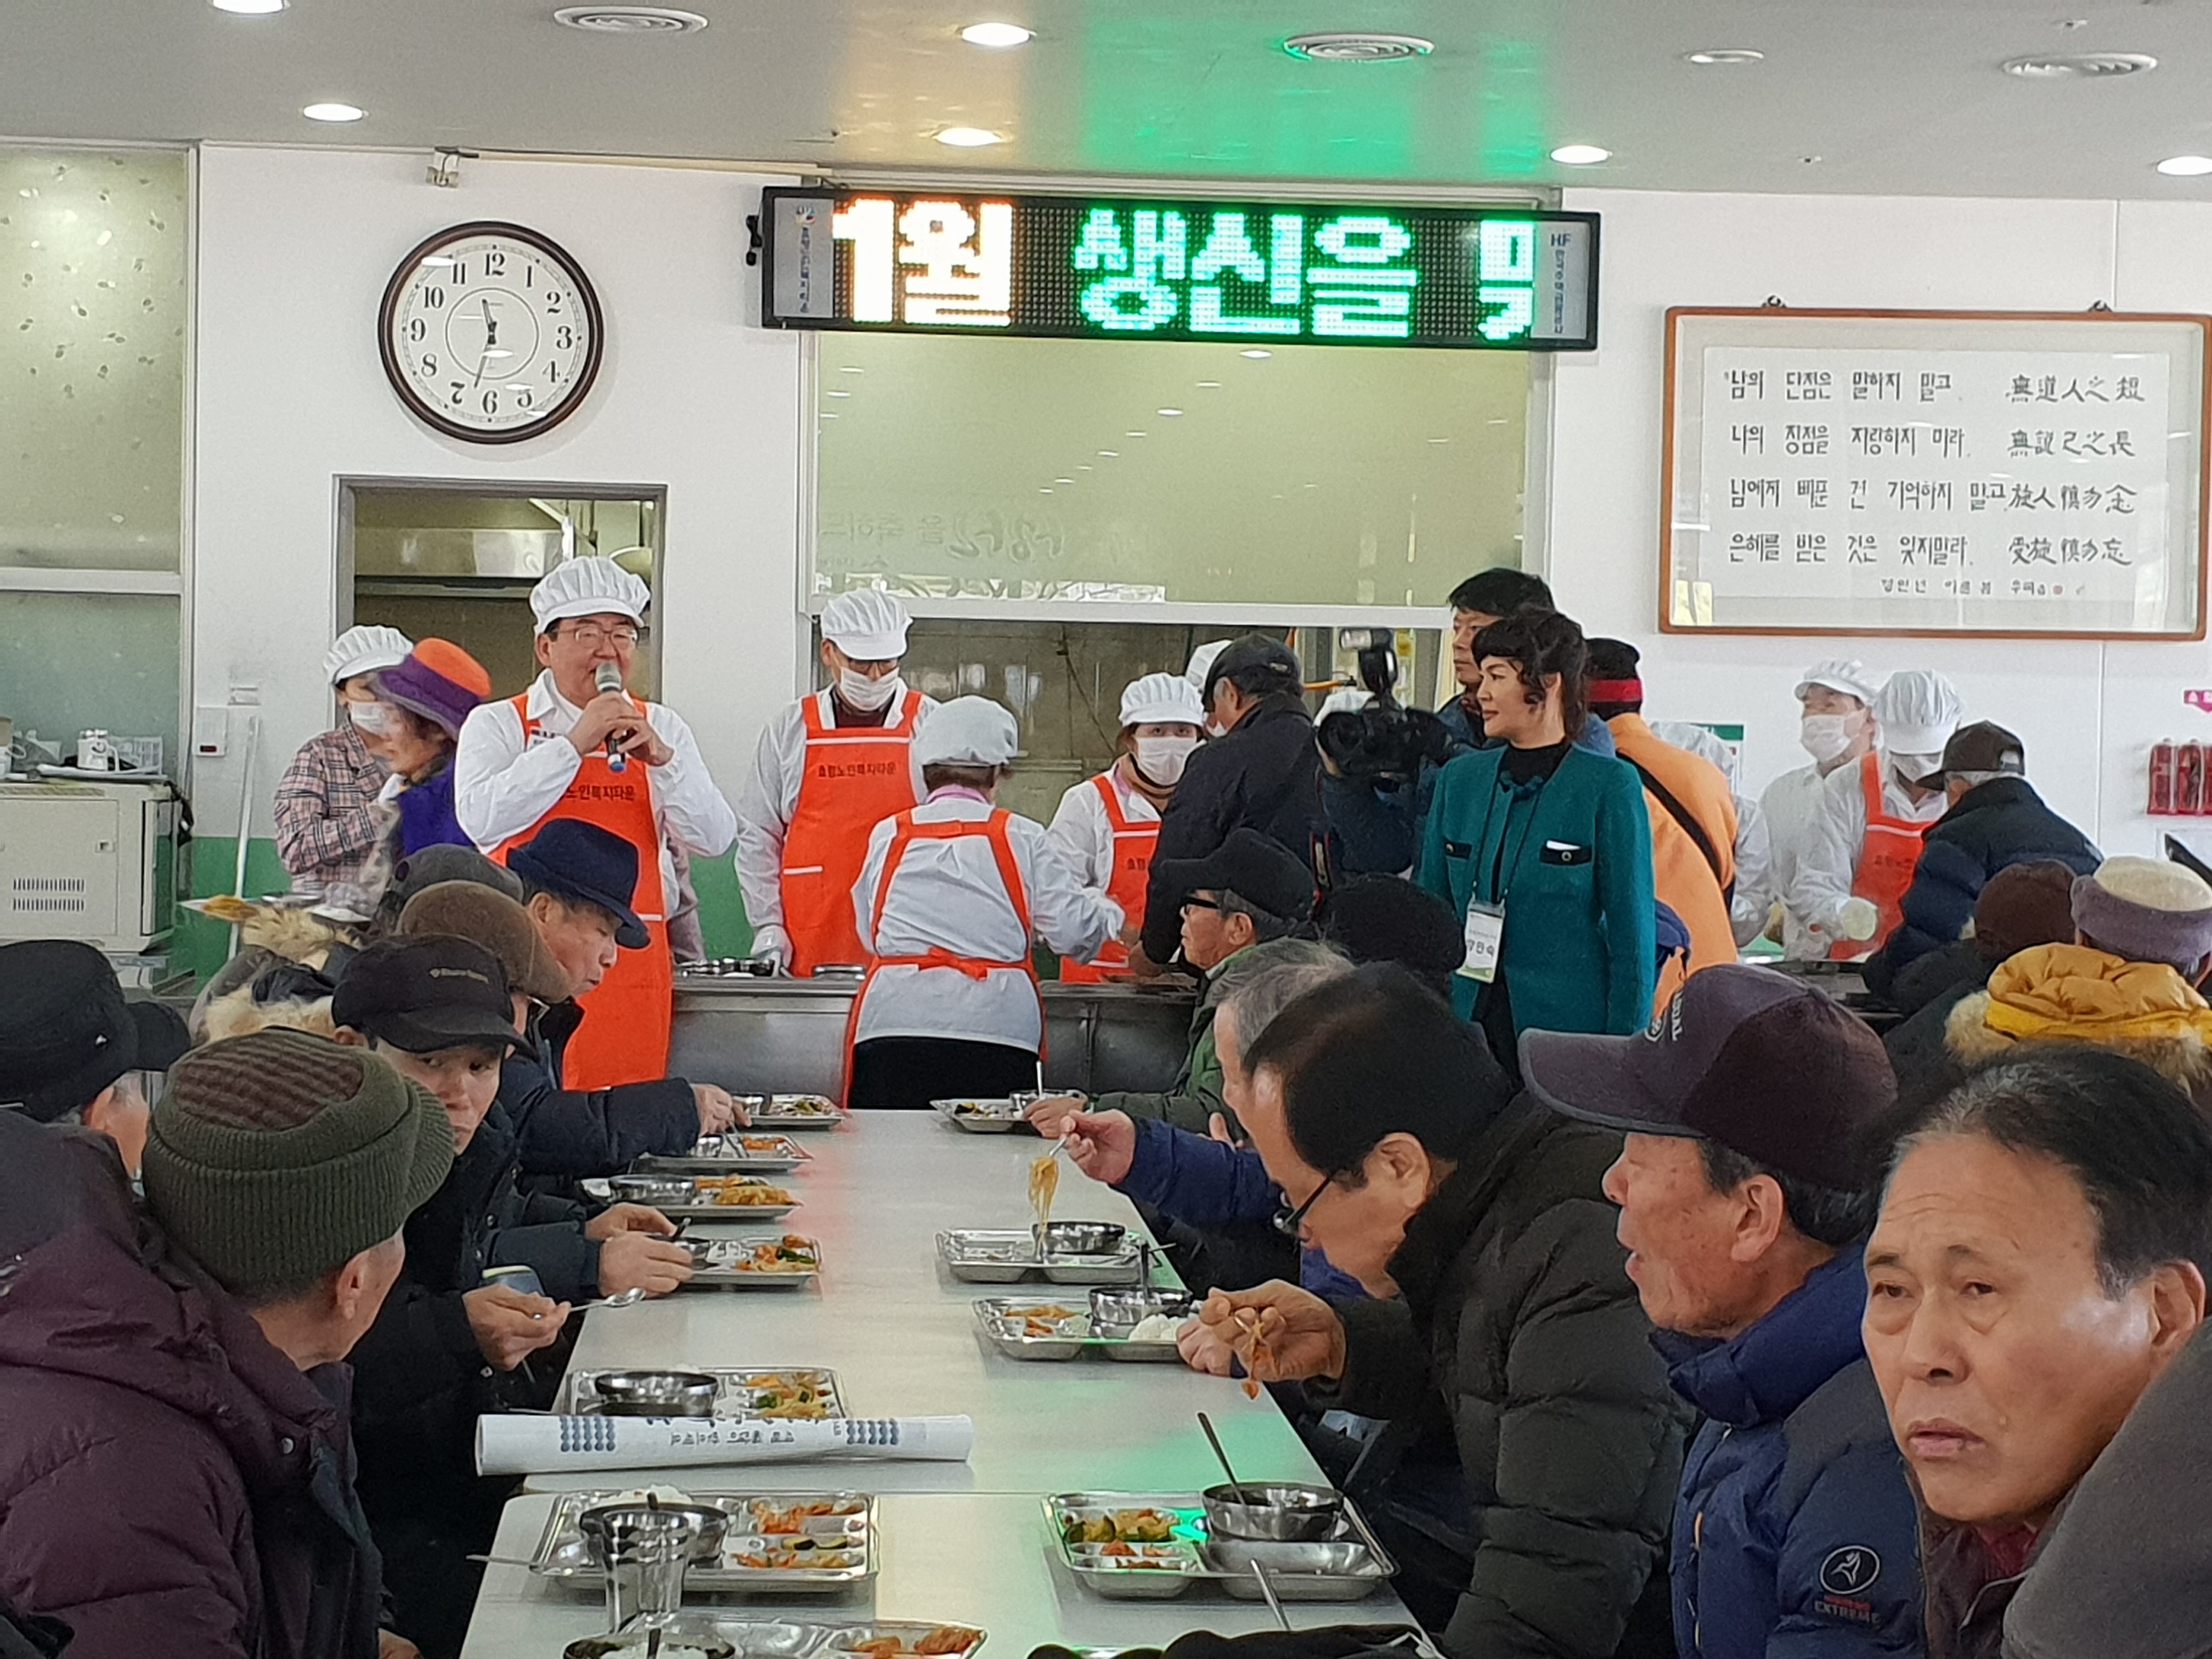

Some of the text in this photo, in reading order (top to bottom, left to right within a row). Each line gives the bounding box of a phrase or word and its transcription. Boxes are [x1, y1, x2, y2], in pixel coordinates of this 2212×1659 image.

[452, 262, 466, 285] 11
[484, 253, 505, 276] 12
[526, 265, 532, 288] 1
[832, 198, 1013, 326] 1월
[1073, 208, 1416, 337] 생신을
[424, 286, 444, 309] 10
[546, 291, 561, 314] 2
[410, 318, 426, 342] 9
[556, 325, 573, 350] 3
[421, 353, 437, 377] 8
[542, 360, 560, 383] 4
[450, 381, 465, 404] 7
[517, 387, 533, 408] 5
[1786, 371, 1831, 400] 단점은
[1853, 371, 1901, 401] 말하지
[482, 390, 498, 414] 6
[1732, 424, 1764, 455] 나의
[1785, 425, 1829, 455] 장점을
[1851, 427, 1915, 456] 자랑하지
[1731, 478, 1780, 508] 남에게
[1797, 479, 1828, 509] 베푼
[1850, 479, 1867, 510] 건
[1888, 481, 1951, 511] 기억하지
[1729, 533, 1780, 562] 은혜를
[1796, 534, 1826, 563] 받은
[1848, 535, 1877, 564] 것은
